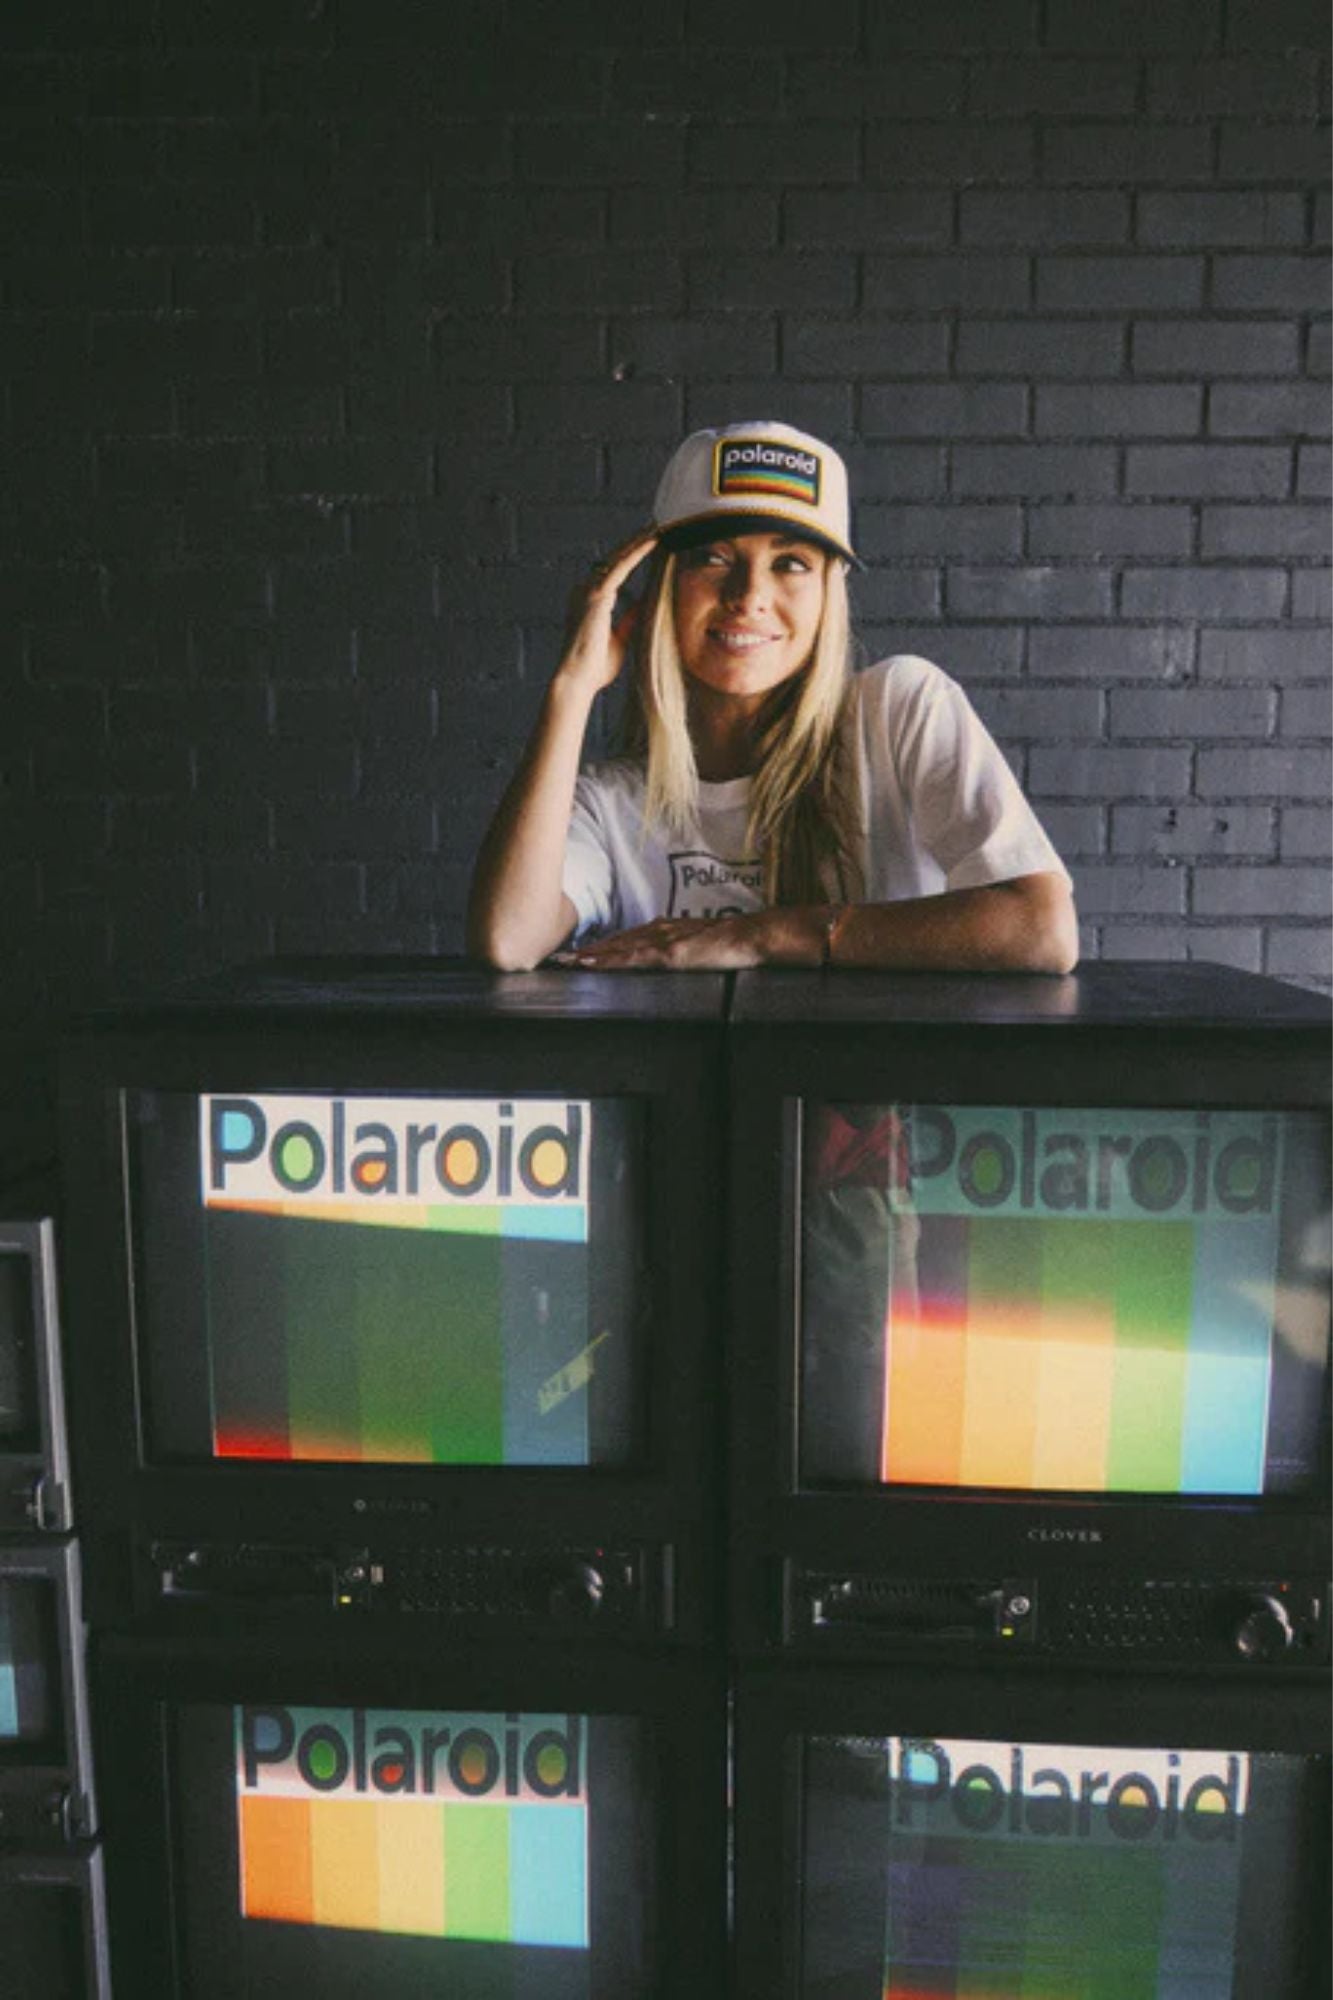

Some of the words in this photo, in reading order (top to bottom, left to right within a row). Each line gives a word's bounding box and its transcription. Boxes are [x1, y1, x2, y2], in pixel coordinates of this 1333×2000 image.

[724, 444, 817, 474] polaroid
[682, 864, 765, 888] Polaroi
[210, 1098, 582, 1197] Polaroid
[903, 1105, 1277, 1214] Polaroid
[1027, 1529, 1103, 1542] CLOVER
[243, 1707, 581, 1798] Polaroid
[897, 1739, 1240, 1842] Polaroid
